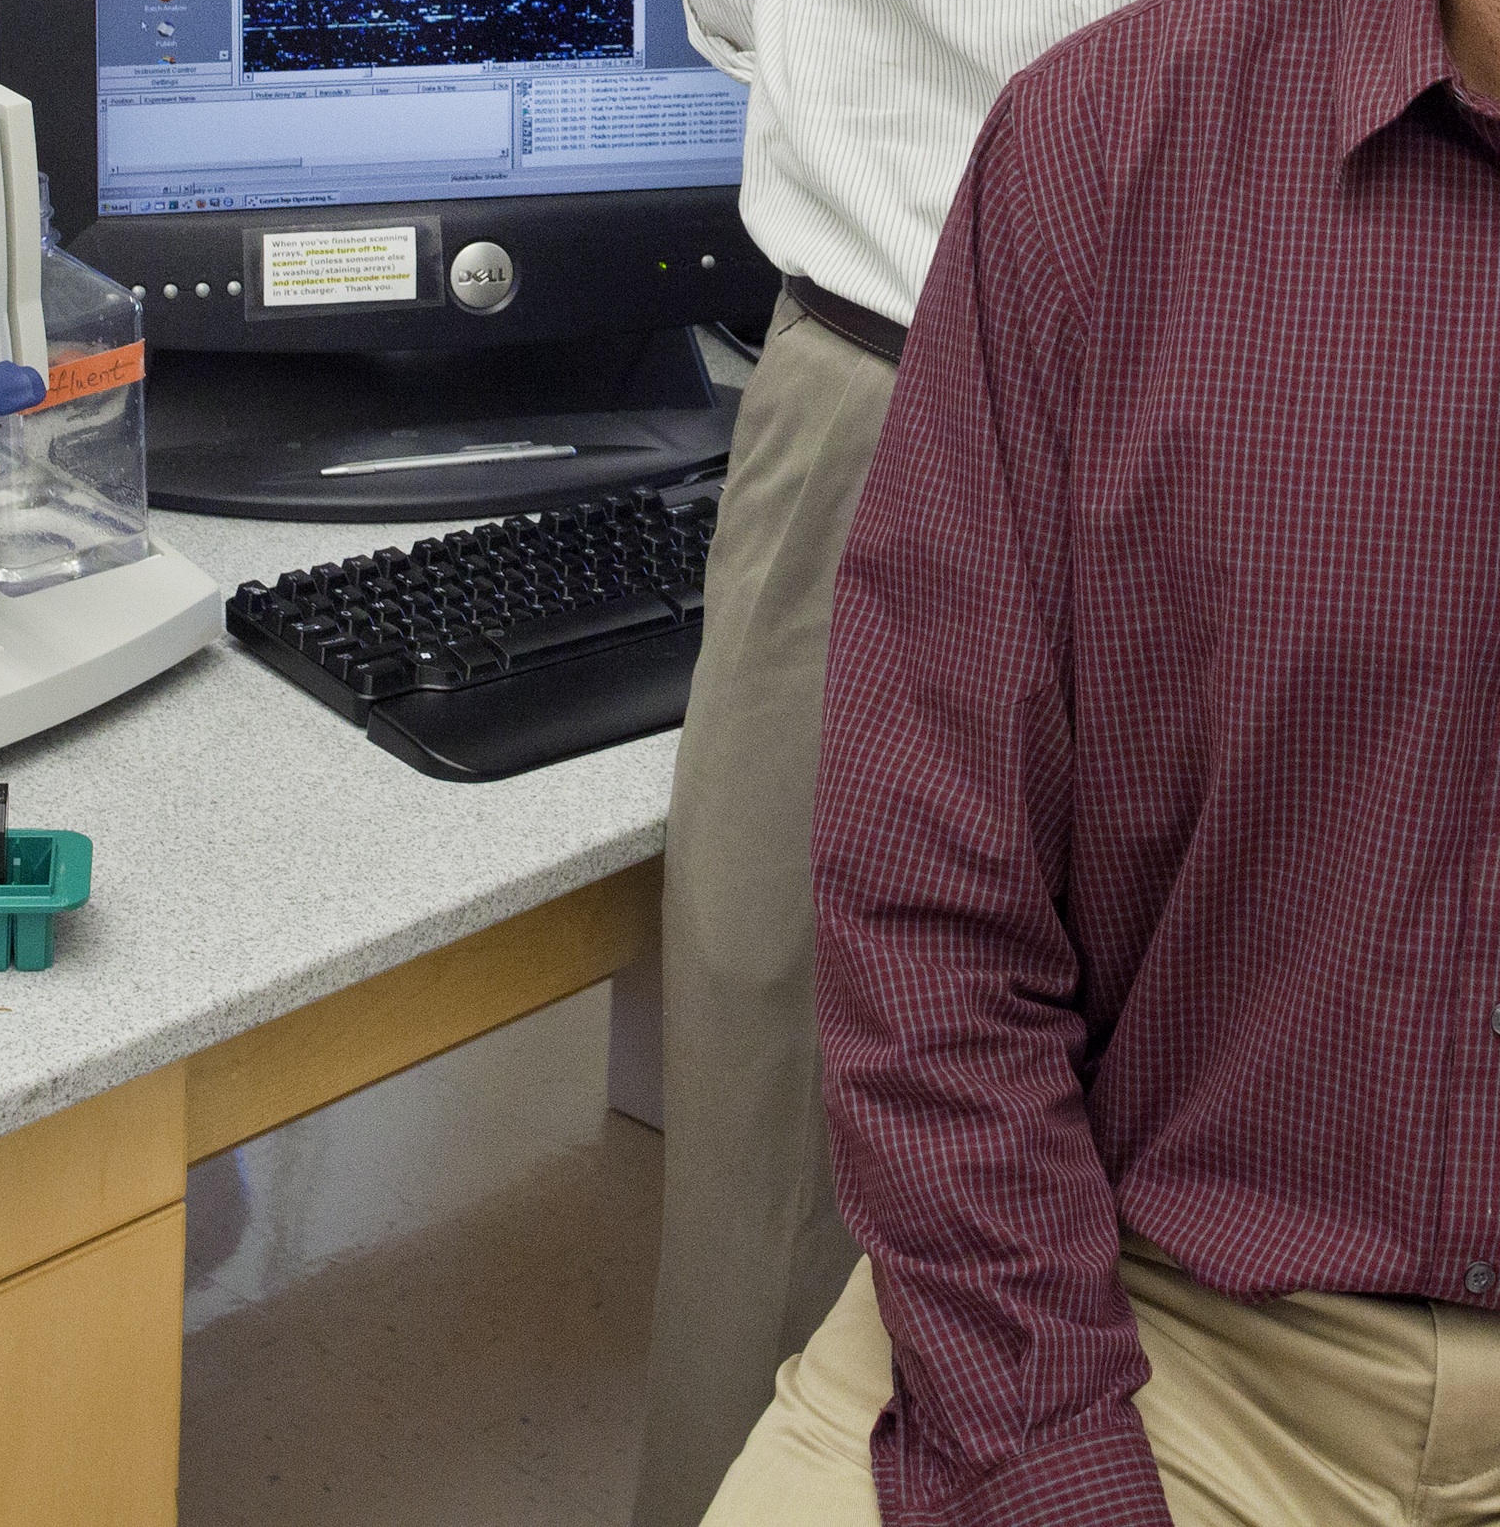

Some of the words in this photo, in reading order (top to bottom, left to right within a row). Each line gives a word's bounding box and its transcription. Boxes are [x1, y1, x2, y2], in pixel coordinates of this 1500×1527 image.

[272, 240, 297, 248] When
[300, 238, 330, 248] you've
[332, 236, 367, 244] finished
[369, 234, 409, 244] scanning
[272, 250, 304, 259] arrays,
[306, 247, 335, 256] please
[358, 245, 370, 253] off
[372, 244, 387, 252] the
[310, 256, 343, 266] (unless
[346, 255, 385, 263] someone
[387, 253, 405, 261] else
[283, 266, 361, 278] washing/staining
[363, 263, 396, 274] arrays)
[458, 267, 506, 286] DELL
[272, 279, 290, 287] and
[291, 277, 324, 287] replace
[326, 276, 342, 284] the
[343, 274, 379, 282] barcode
[381, 273, 410, 281] reader
[284, 287, 298, 296] it's
[300, 287, 337, 297] charger.
[345, 284, 372, 293] Thank
[374, 284, 393, 293] you.
[50, 360, 134, 395] ffluent
